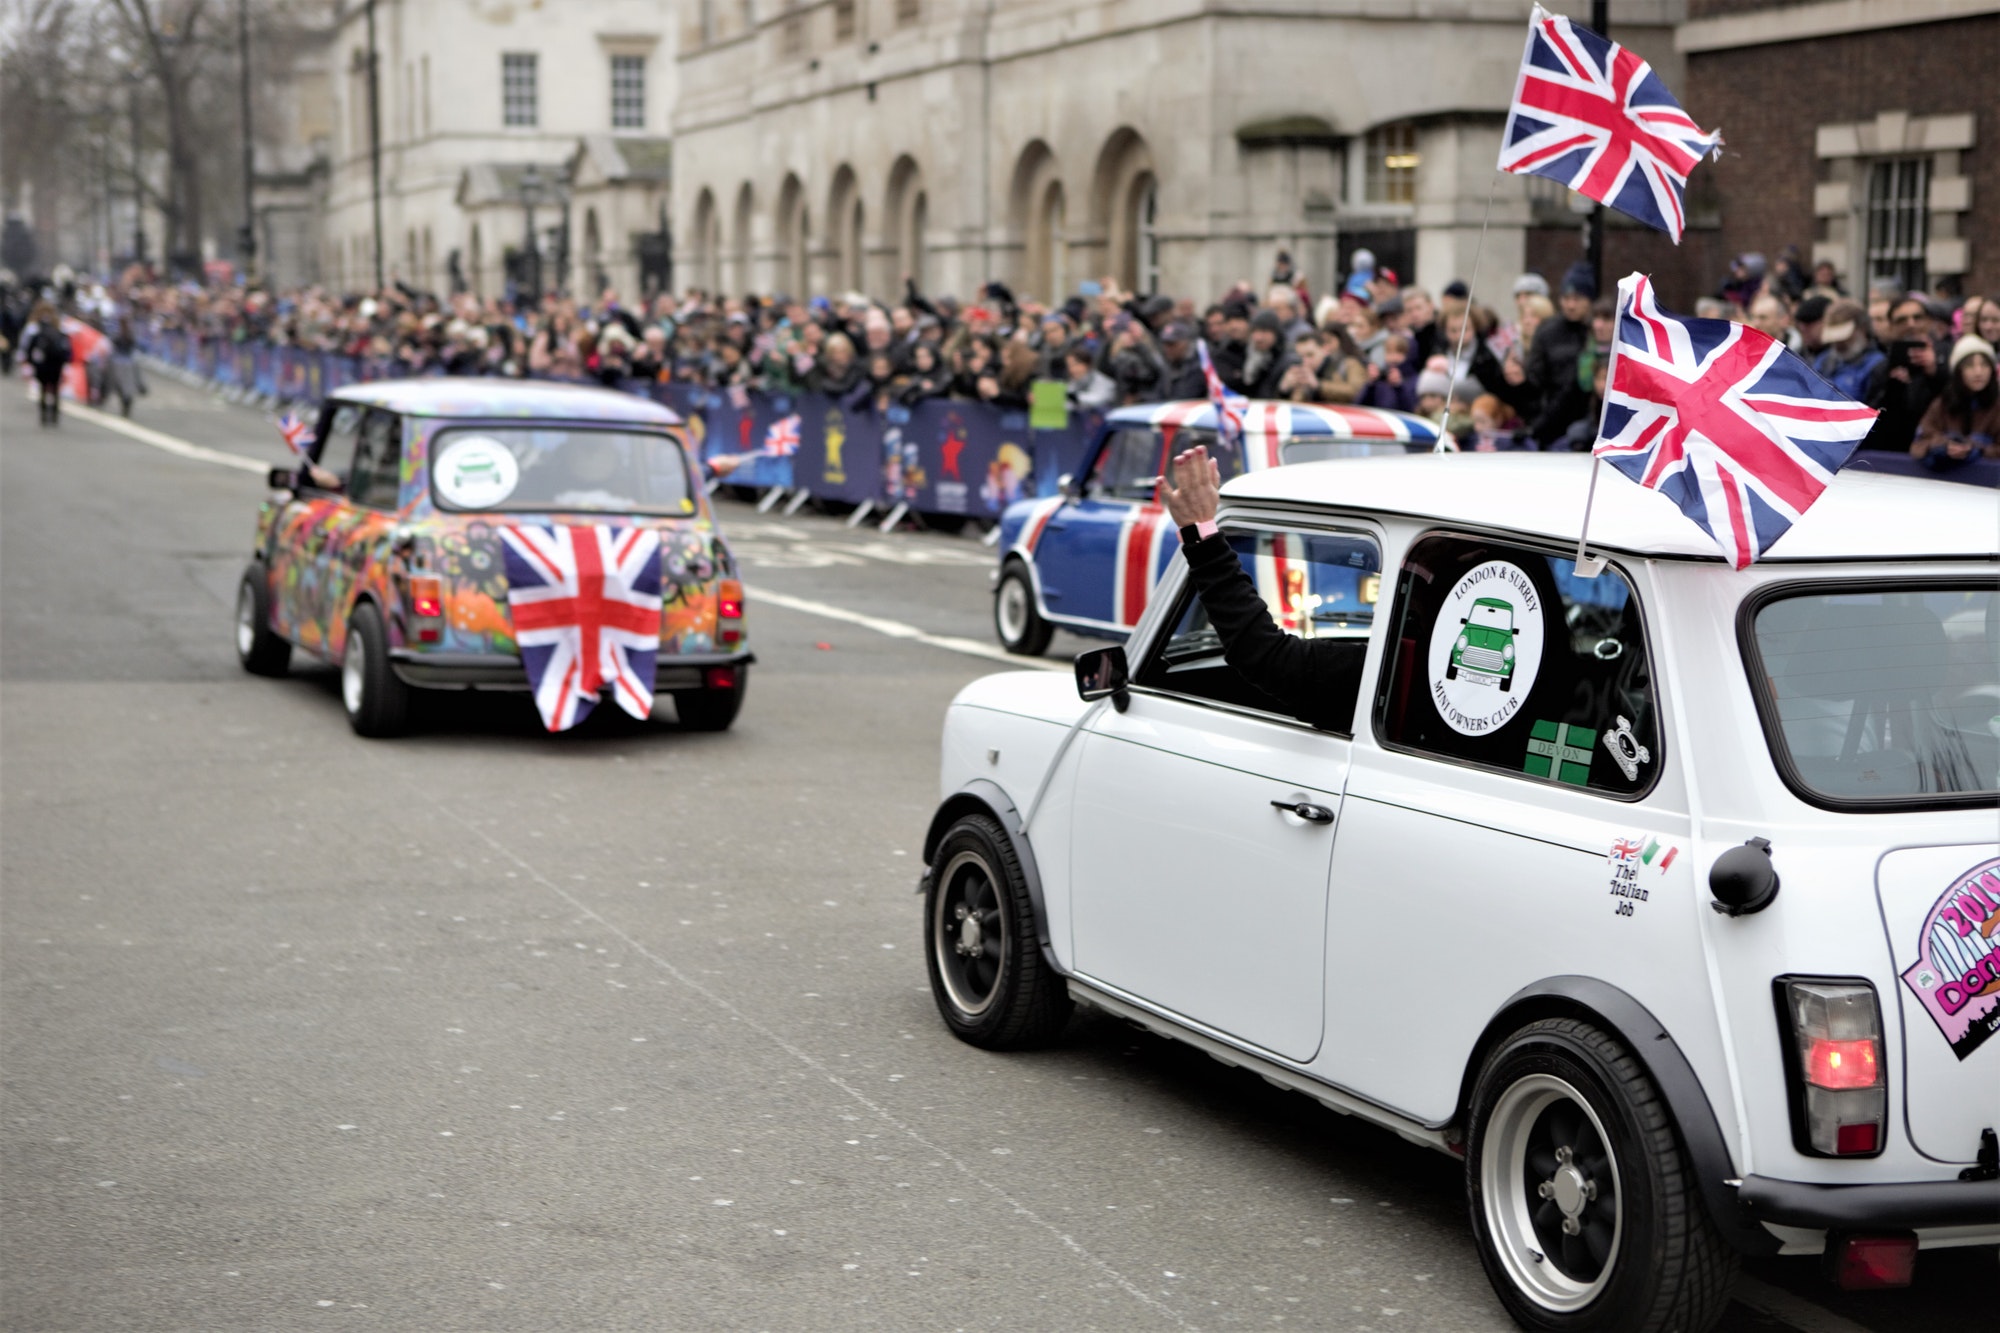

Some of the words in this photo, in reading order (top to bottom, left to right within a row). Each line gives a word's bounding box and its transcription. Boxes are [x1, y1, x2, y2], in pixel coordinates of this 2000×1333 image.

[1455, 566, 1497, 600] LONDON
[1500, 566, 1507, 579] &
[1508, 570, 1537, 612] SURREY
[1434, 680, 1450, 711] MINI
[1449, 708, 1488, 731] OWNERS
[1492, 697, 1518, 726] CLUB
[1537, 743, 1581, 760] DEVON
[1616, 864, 1636, 880] The
[1610, 880, 1649, 901] Italian
[1615, 901, 1634, 917] Job
